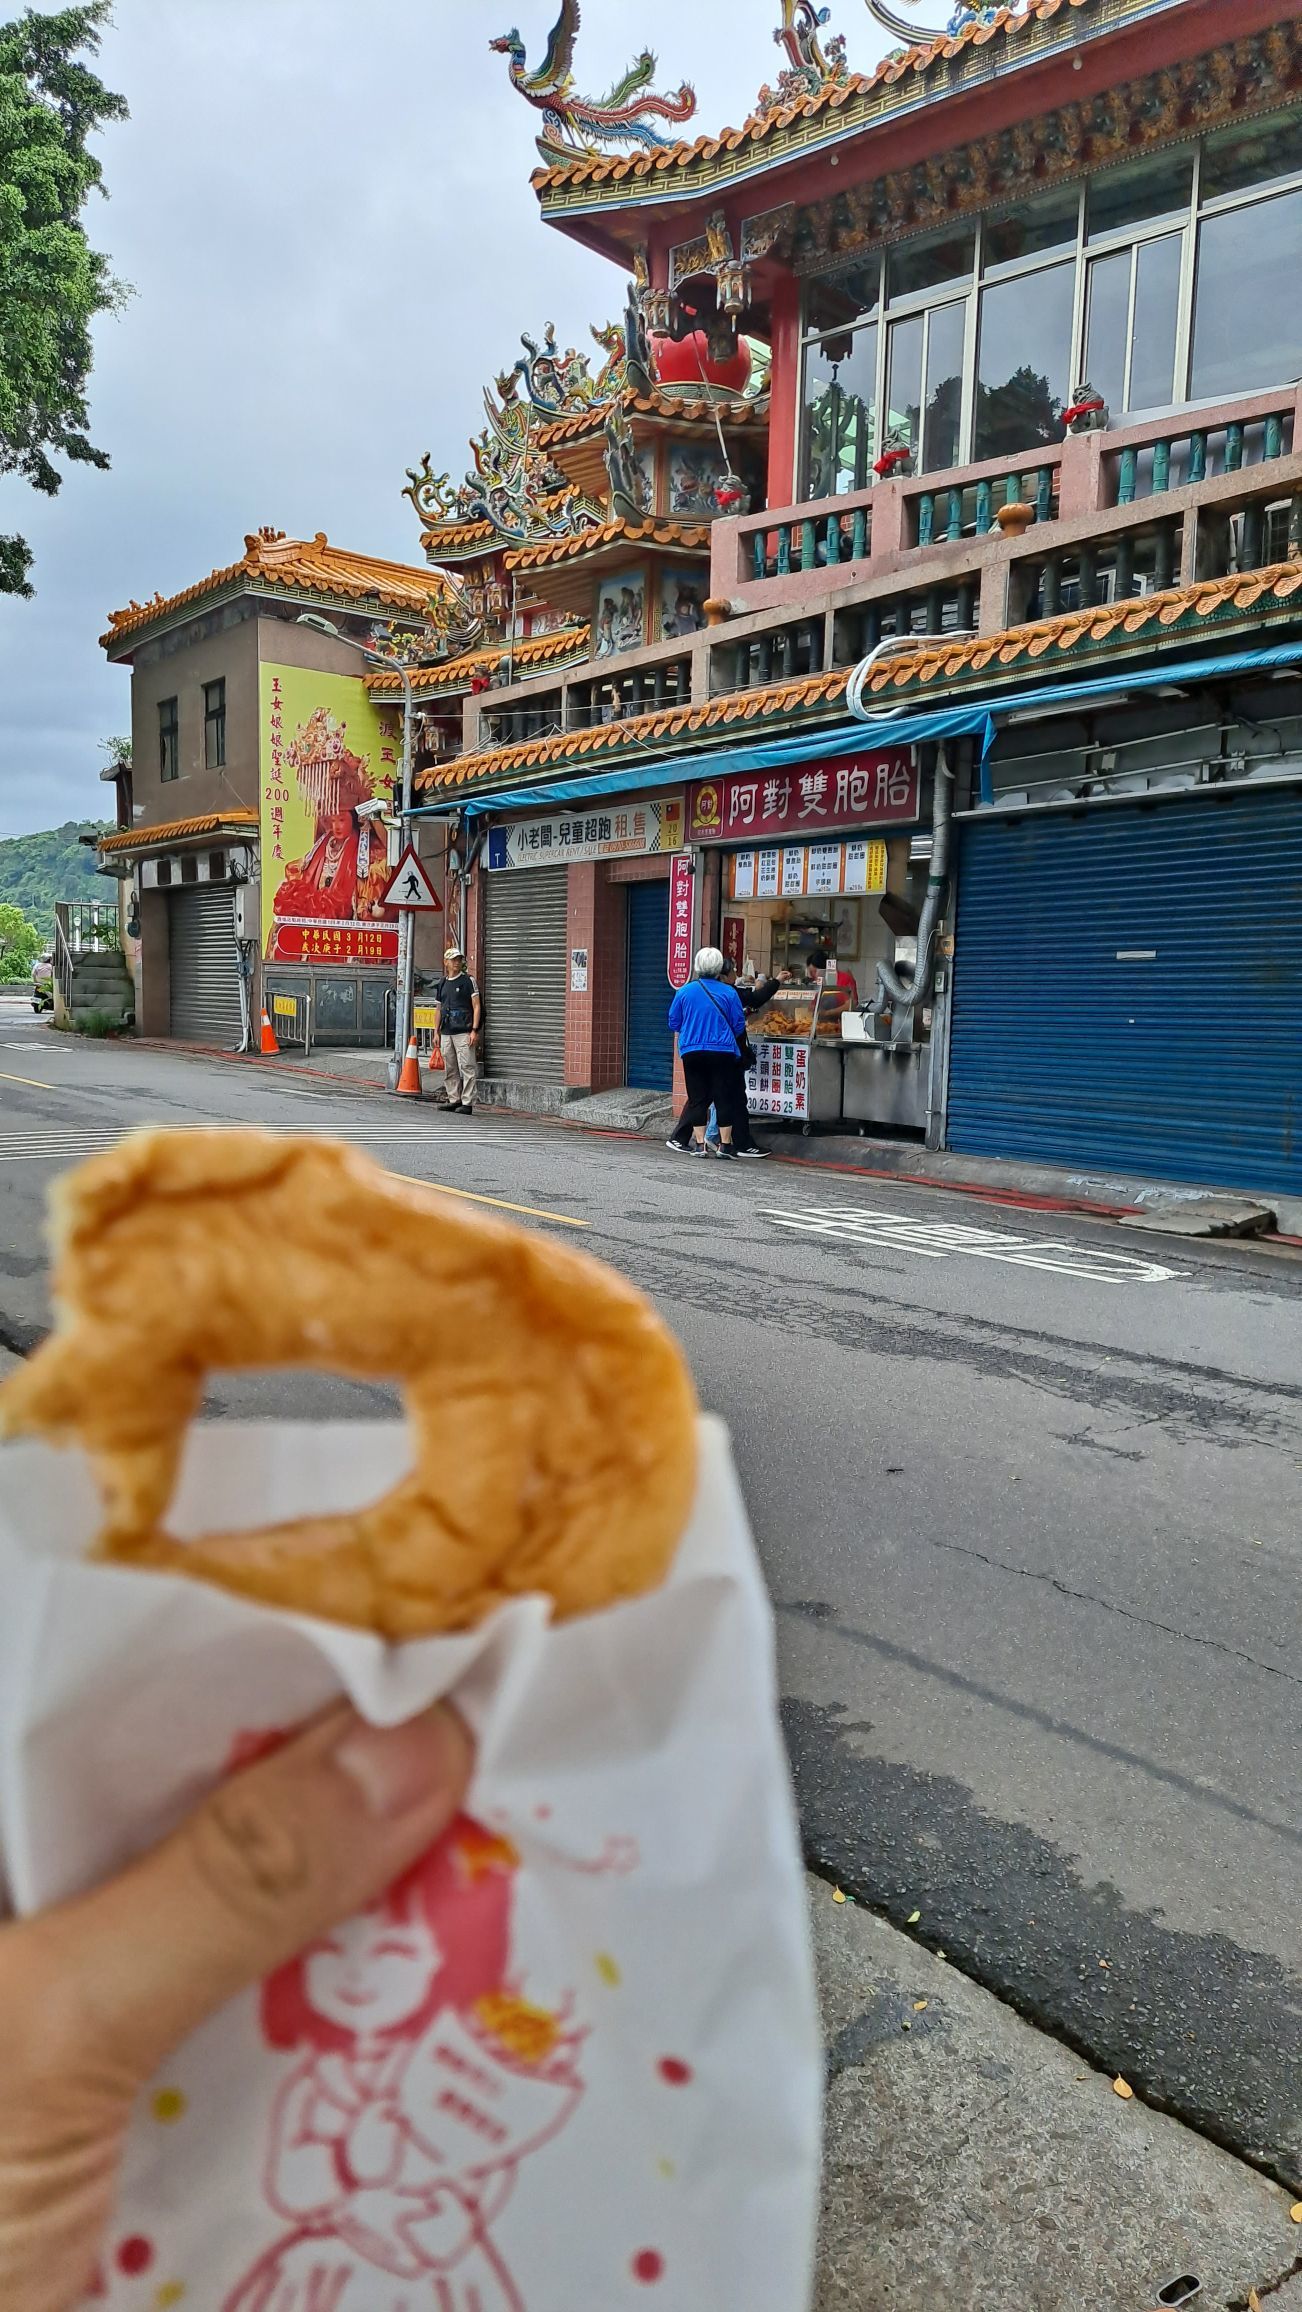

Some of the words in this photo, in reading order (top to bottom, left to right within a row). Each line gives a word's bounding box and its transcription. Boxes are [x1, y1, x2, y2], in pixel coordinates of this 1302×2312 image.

[728, 759, 911, 827] 阿對雙胞胎
[673, 859, 690, 959] 阿對雙胞胎
[784, 1046, 794, 1094] 雙胞胎
[795, 1049, 807, 1111] 蛋奶素
[760, 1098, 769, 1111] 25
[771, 1100, 781, 1112] 25
[784, 1101, 793, 1114] 25
